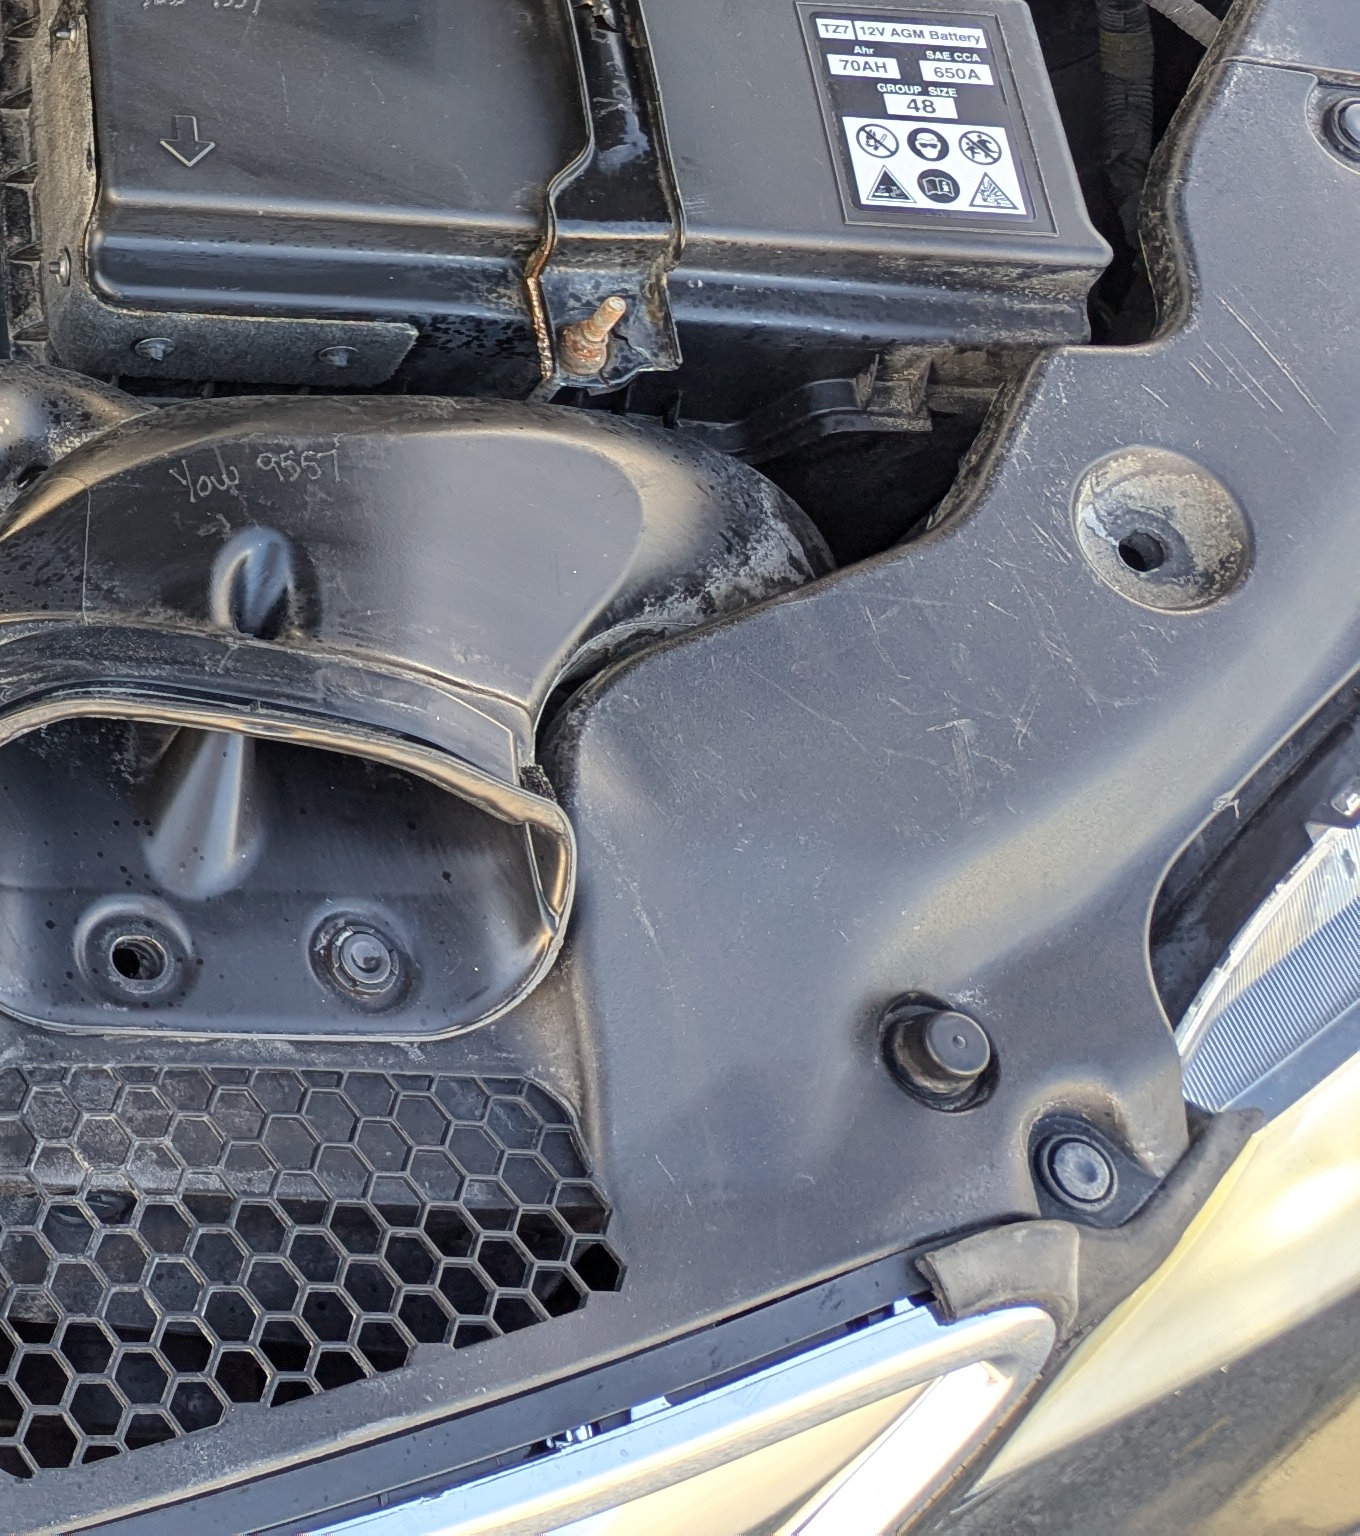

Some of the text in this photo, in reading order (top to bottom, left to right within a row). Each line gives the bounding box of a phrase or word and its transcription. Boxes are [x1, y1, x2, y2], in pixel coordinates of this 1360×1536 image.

[821, 23, 981, 45] TZ7 12V AGM Battery
[853, 45, 875, 55] Ahr
[925, 50, 981, 63] SAE CCA
[839, 59, 889, 74] 70AH
[933, 66, 982, 81] 650A
[876, 83, 958, 97] GROUP SIZE
[906, 98, 937, 114] 48
[256, 448, 342, 483] 9557
